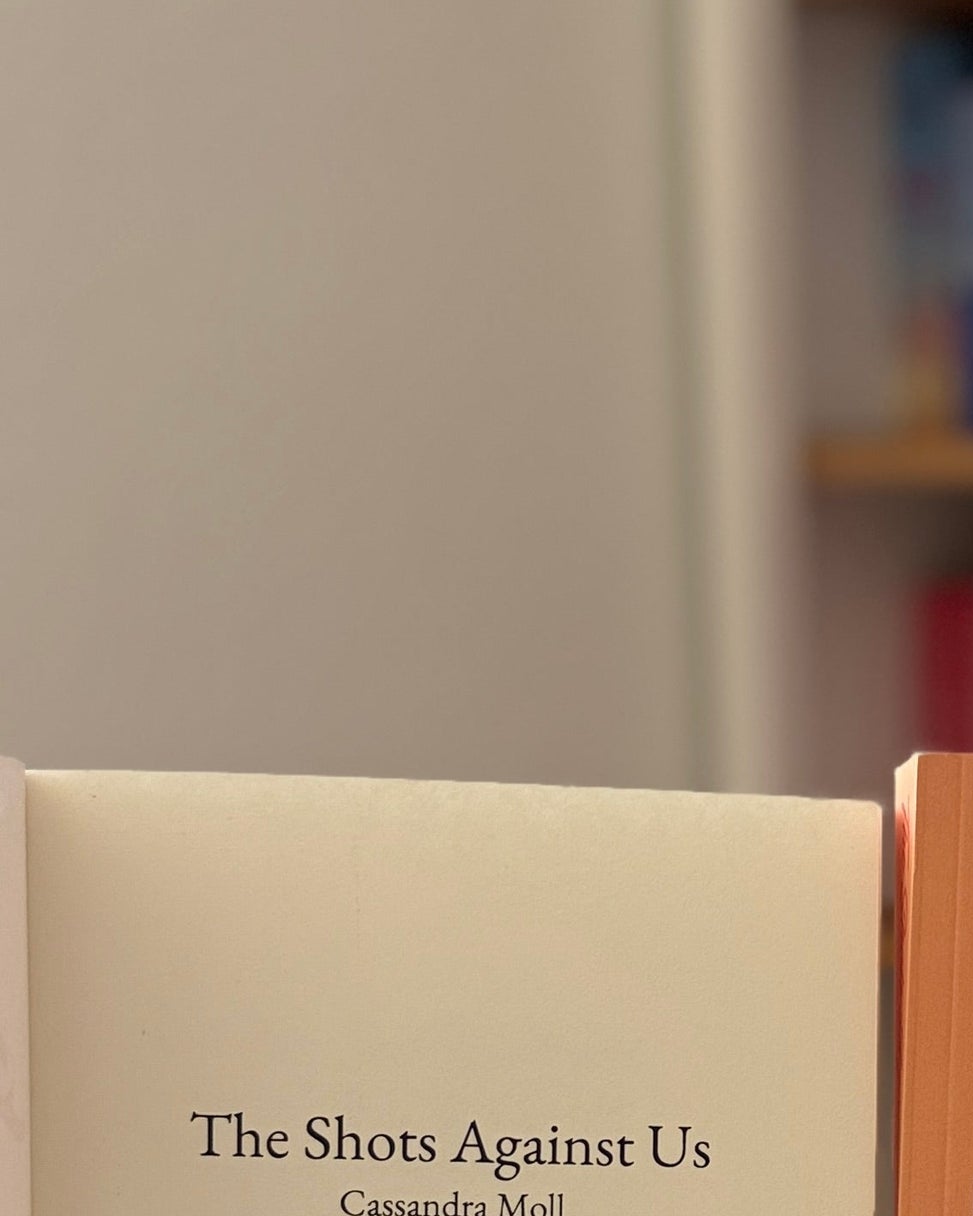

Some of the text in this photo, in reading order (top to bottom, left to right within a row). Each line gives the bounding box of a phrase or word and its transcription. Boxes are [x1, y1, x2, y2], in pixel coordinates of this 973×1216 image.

[191, 1111, 712, 1181] The Shots Against Us
